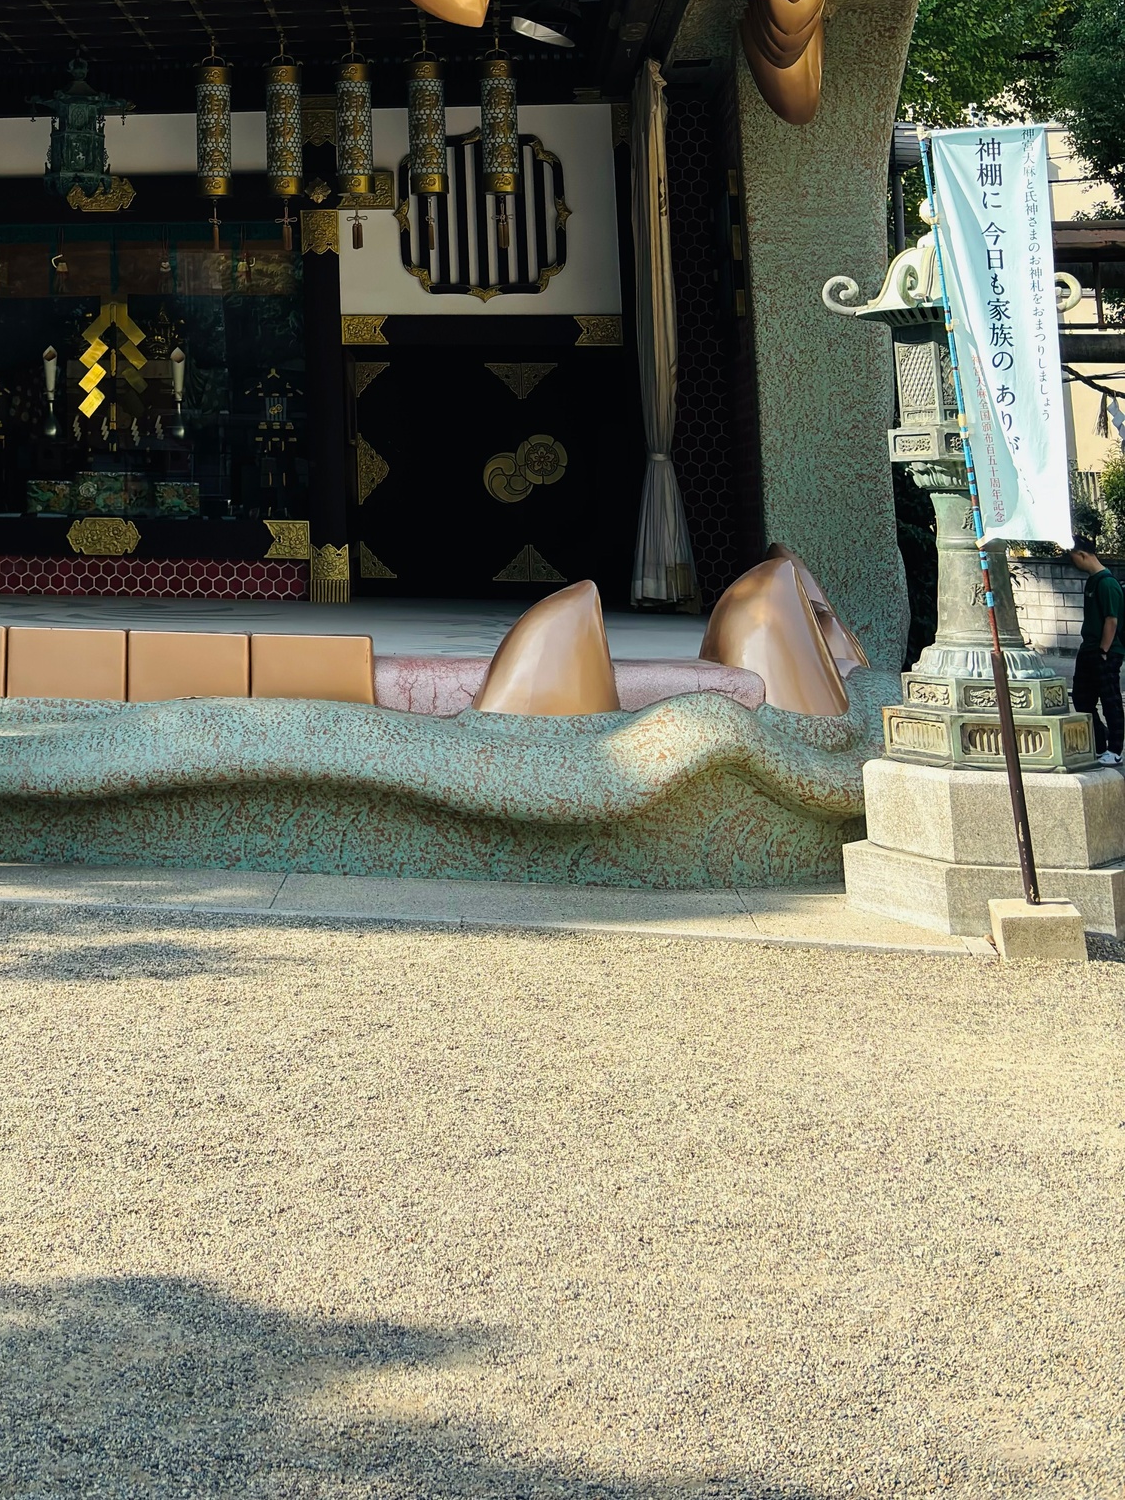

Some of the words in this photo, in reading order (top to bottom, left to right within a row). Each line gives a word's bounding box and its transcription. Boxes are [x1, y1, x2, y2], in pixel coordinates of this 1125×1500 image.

[975, 138, 1002, 209] 神棚に
[981, 222, 1014, 372] 今日も家族の
[1021, 128, 1050, 421] 神宮大麻と氏神さまのお神札をおまつりしましょう
